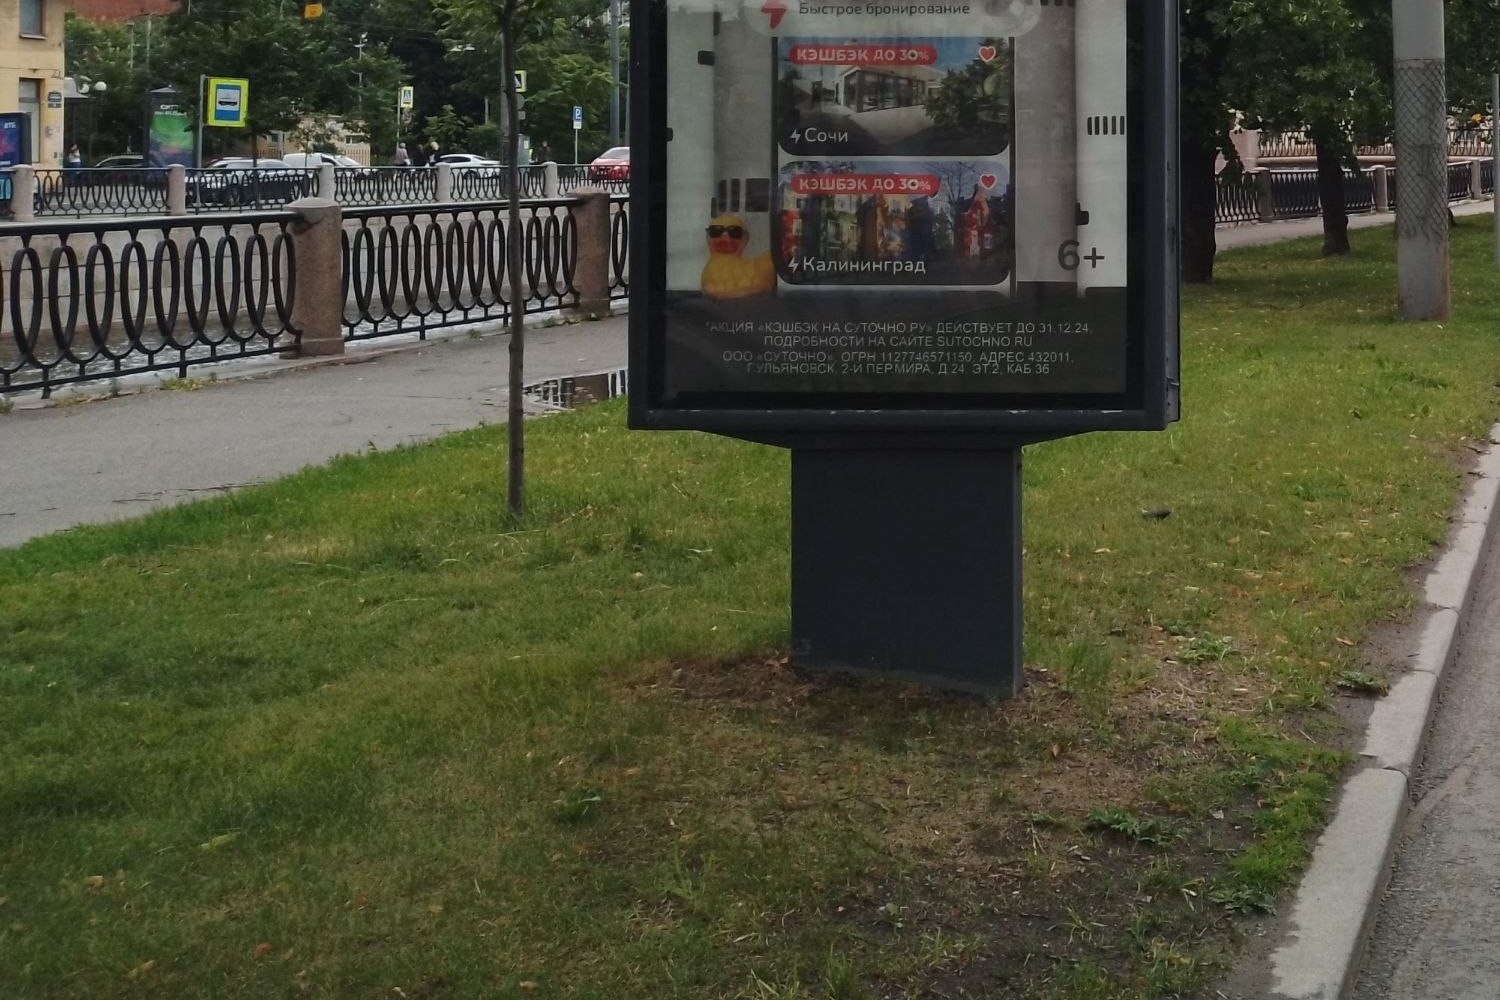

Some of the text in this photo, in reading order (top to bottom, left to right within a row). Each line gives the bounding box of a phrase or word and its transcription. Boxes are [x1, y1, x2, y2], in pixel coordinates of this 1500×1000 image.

[799, 1, 970, 16] Быстрое бронирование
[796, 50, 930, 62] КЭШБЭК ДО 30%
[804, 127, 849, 143] Сочи
[799, 177, 932, 191] КЭШБЭК ДО 30%
[1058, 239, 1106, 271] 6+
[803, 255, 926, 275] Калининград
[823, 322, 841, 333] НА
[936, 321, 1013, 335] ДЕЙСТВУЕТ
[1016, 322, 1035, 335] ДО
[764, 336, 864, 348] ПОДРОБНОСТИ
[868, 336, 886, 347] НА
[889, 335, 933, 347] САЙТЕ
[722, 350, 753, 362] ООО
[841, 351, 876, 362] ОГРН
